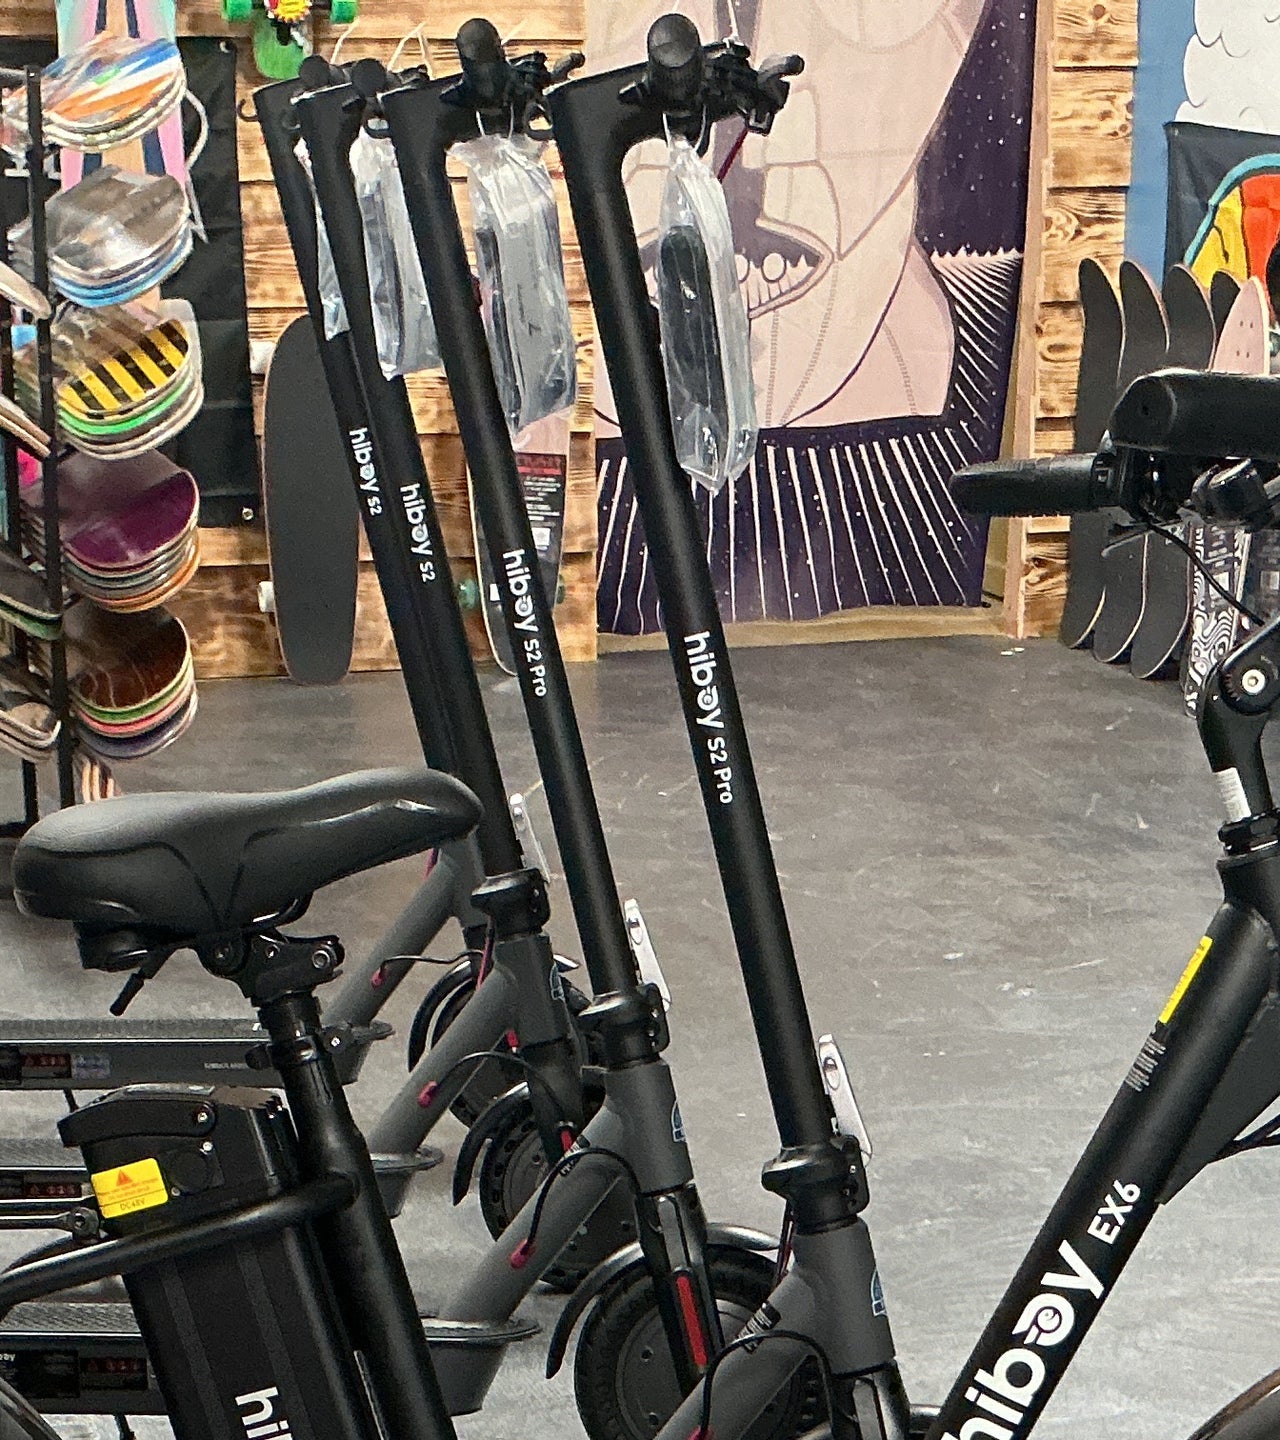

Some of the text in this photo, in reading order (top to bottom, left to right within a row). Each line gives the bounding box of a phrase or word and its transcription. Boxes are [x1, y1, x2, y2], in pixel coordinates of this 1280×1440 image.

[349, 427, 383, 516] hiboy S2
[399, 482, 436, 583] hiboy S2
[503, 549, 547, 697] hiboy S2 Pro
[683, 631, 733, 805] hiboy S2 Pro
[1086, 1179, 1141, 1245] EX6
